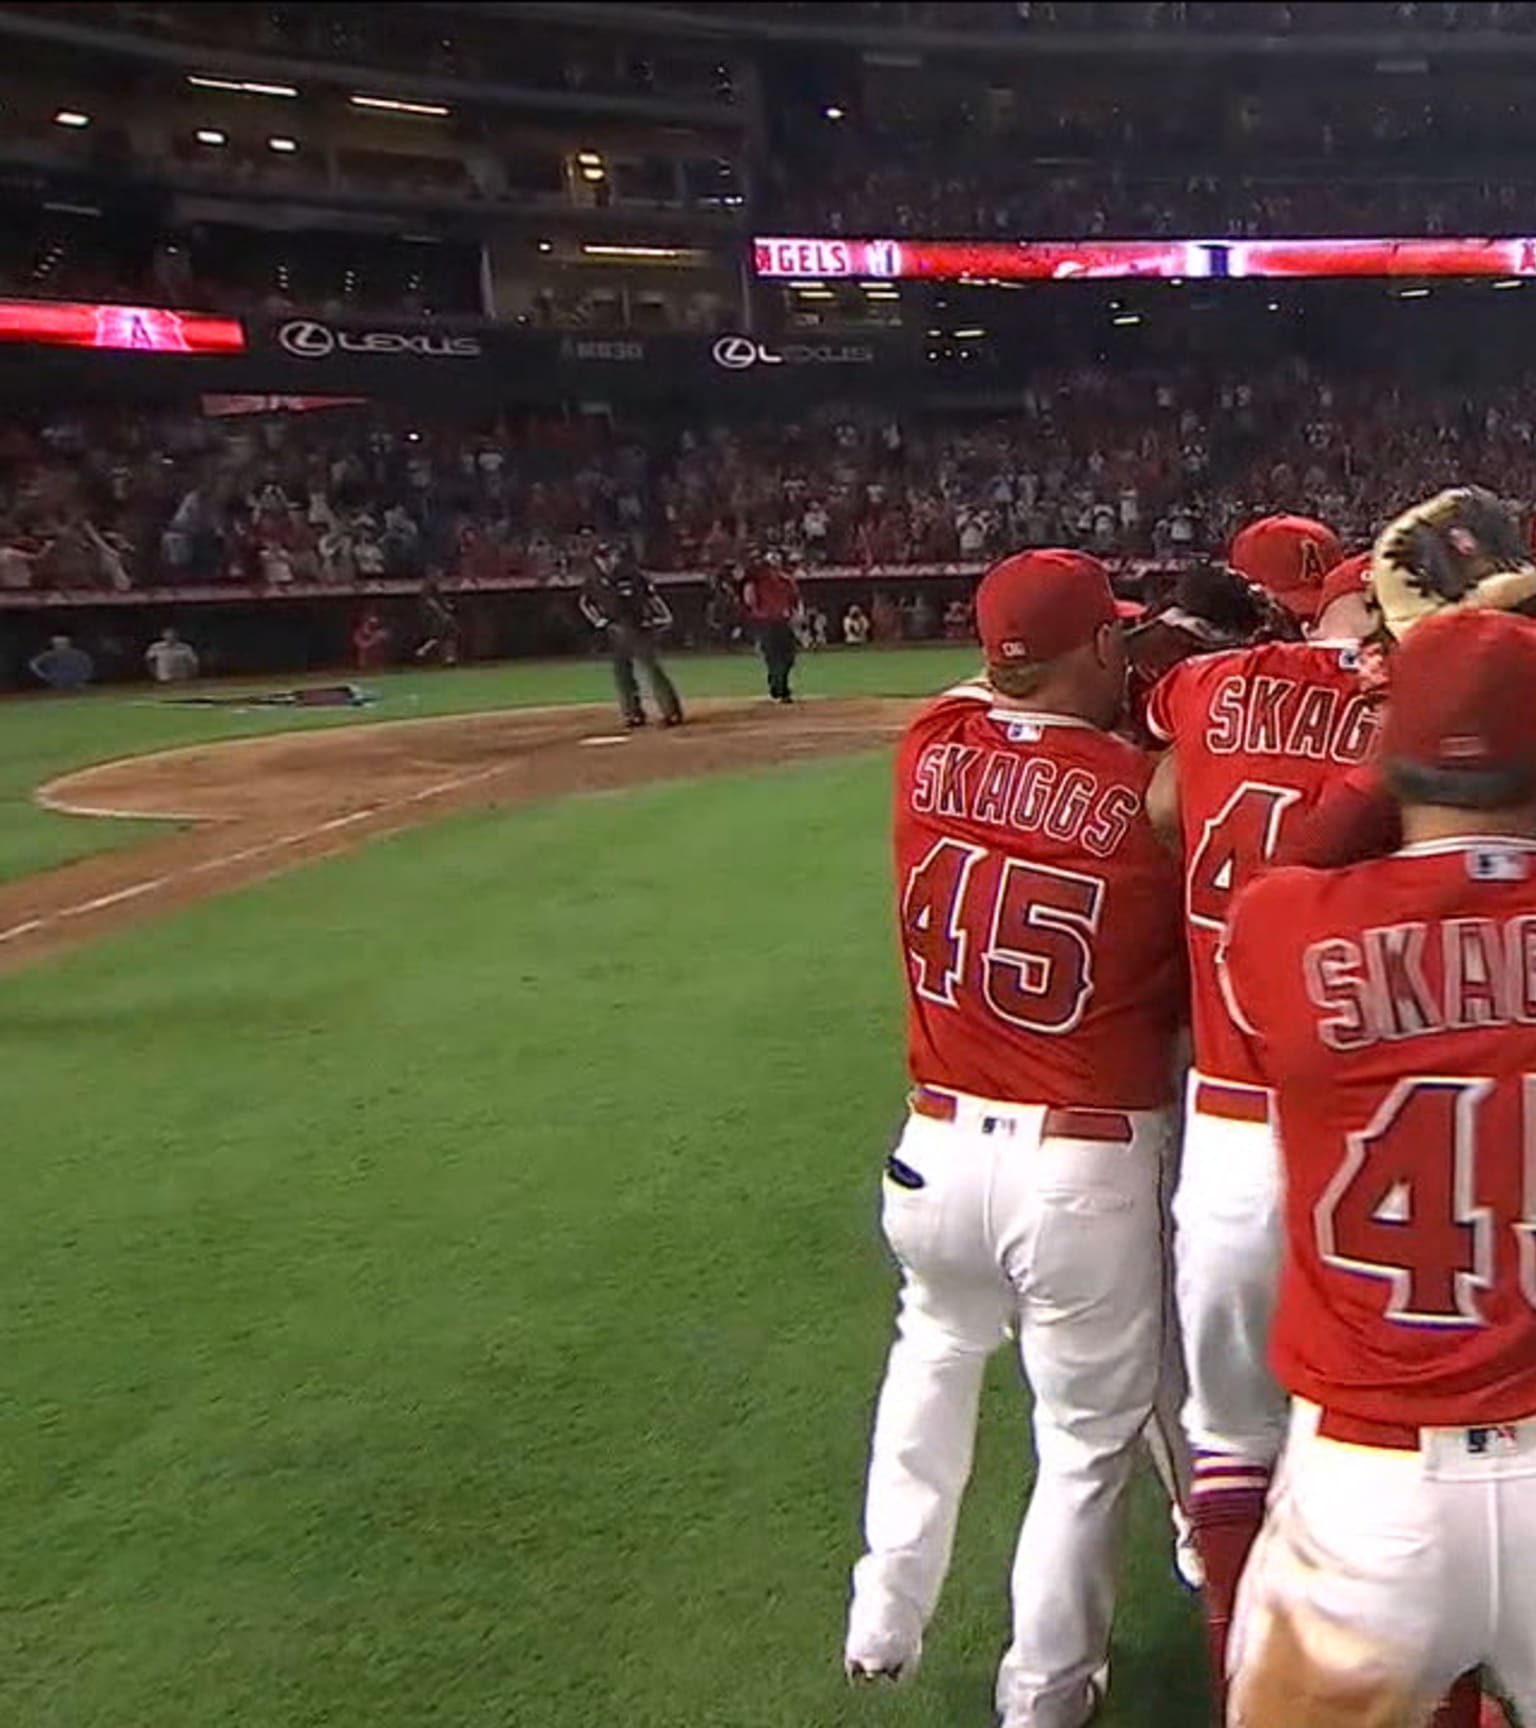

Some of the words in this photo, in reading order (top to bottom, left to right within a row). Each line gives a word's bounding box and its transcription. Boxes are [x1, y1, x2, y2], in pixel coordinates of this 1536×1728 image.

[338, 331, 481, 356] LEXUS
[912, 743, 1140, 857] SKAGGS
[903, 836, 1106, 1034] 45
